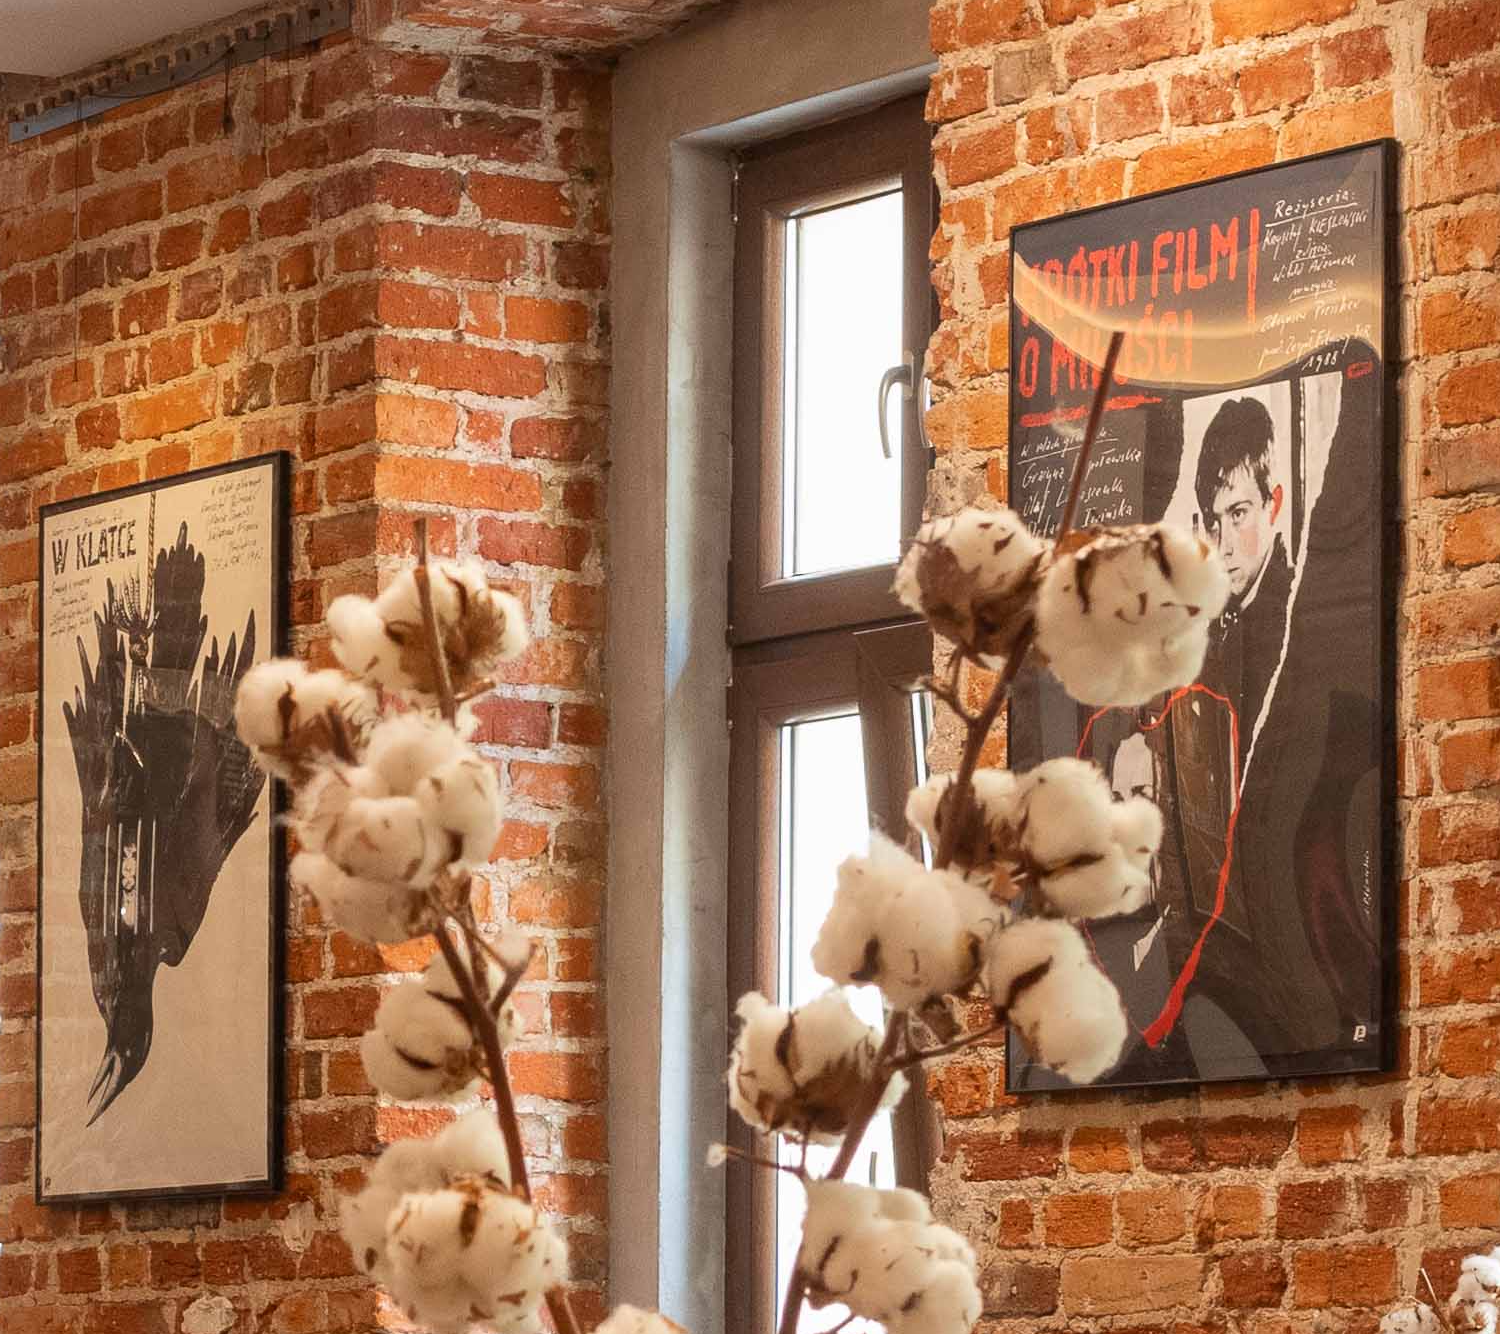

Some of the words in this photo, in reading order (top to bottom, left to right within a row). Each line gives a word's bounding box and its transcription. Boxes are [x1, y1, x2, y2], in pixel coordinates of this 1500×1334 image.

[1151, 216, 1240, 299] FILM
[1019, 335, 1040, 398] O
[52, 538, 69, 575] W
[76, 519, 137, 571] KLATCE
